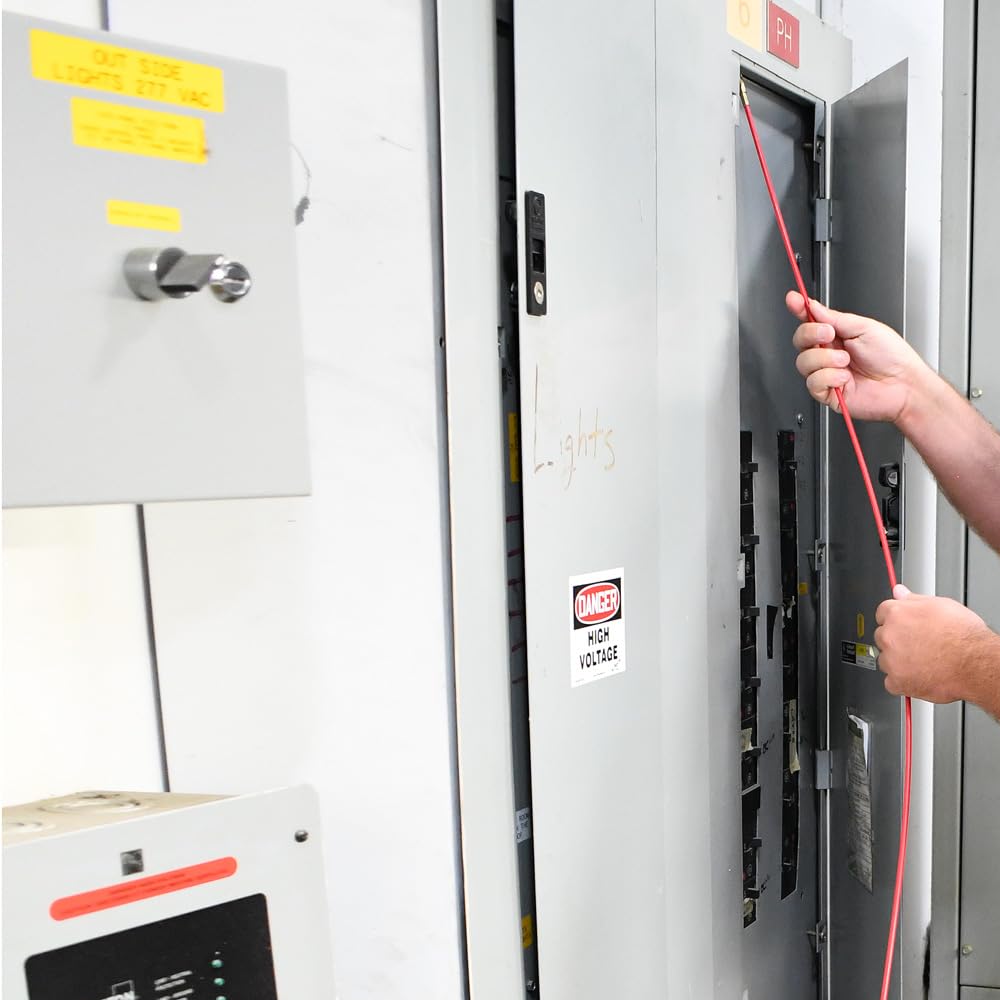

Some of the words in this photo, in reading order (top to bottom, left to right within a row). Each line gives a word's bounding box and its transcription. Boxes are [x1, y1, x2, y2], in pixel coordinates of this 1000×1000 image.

[776, 16, 792, 53] PH
[92, 48, 128, 67] OUT
[138, 58, 183, 81] SIDE
[52, 63, 124, 91] LIGHTS
[135, 79, 167, 97] 277
[176, 87, 210, 107] VAC
[533, 361, 616, 491] Lights
[578, 588, 617, 618] DANGER
[588, 626, 609, 647] HIGH
[579, 645, 618, 670] VOLTAGE
